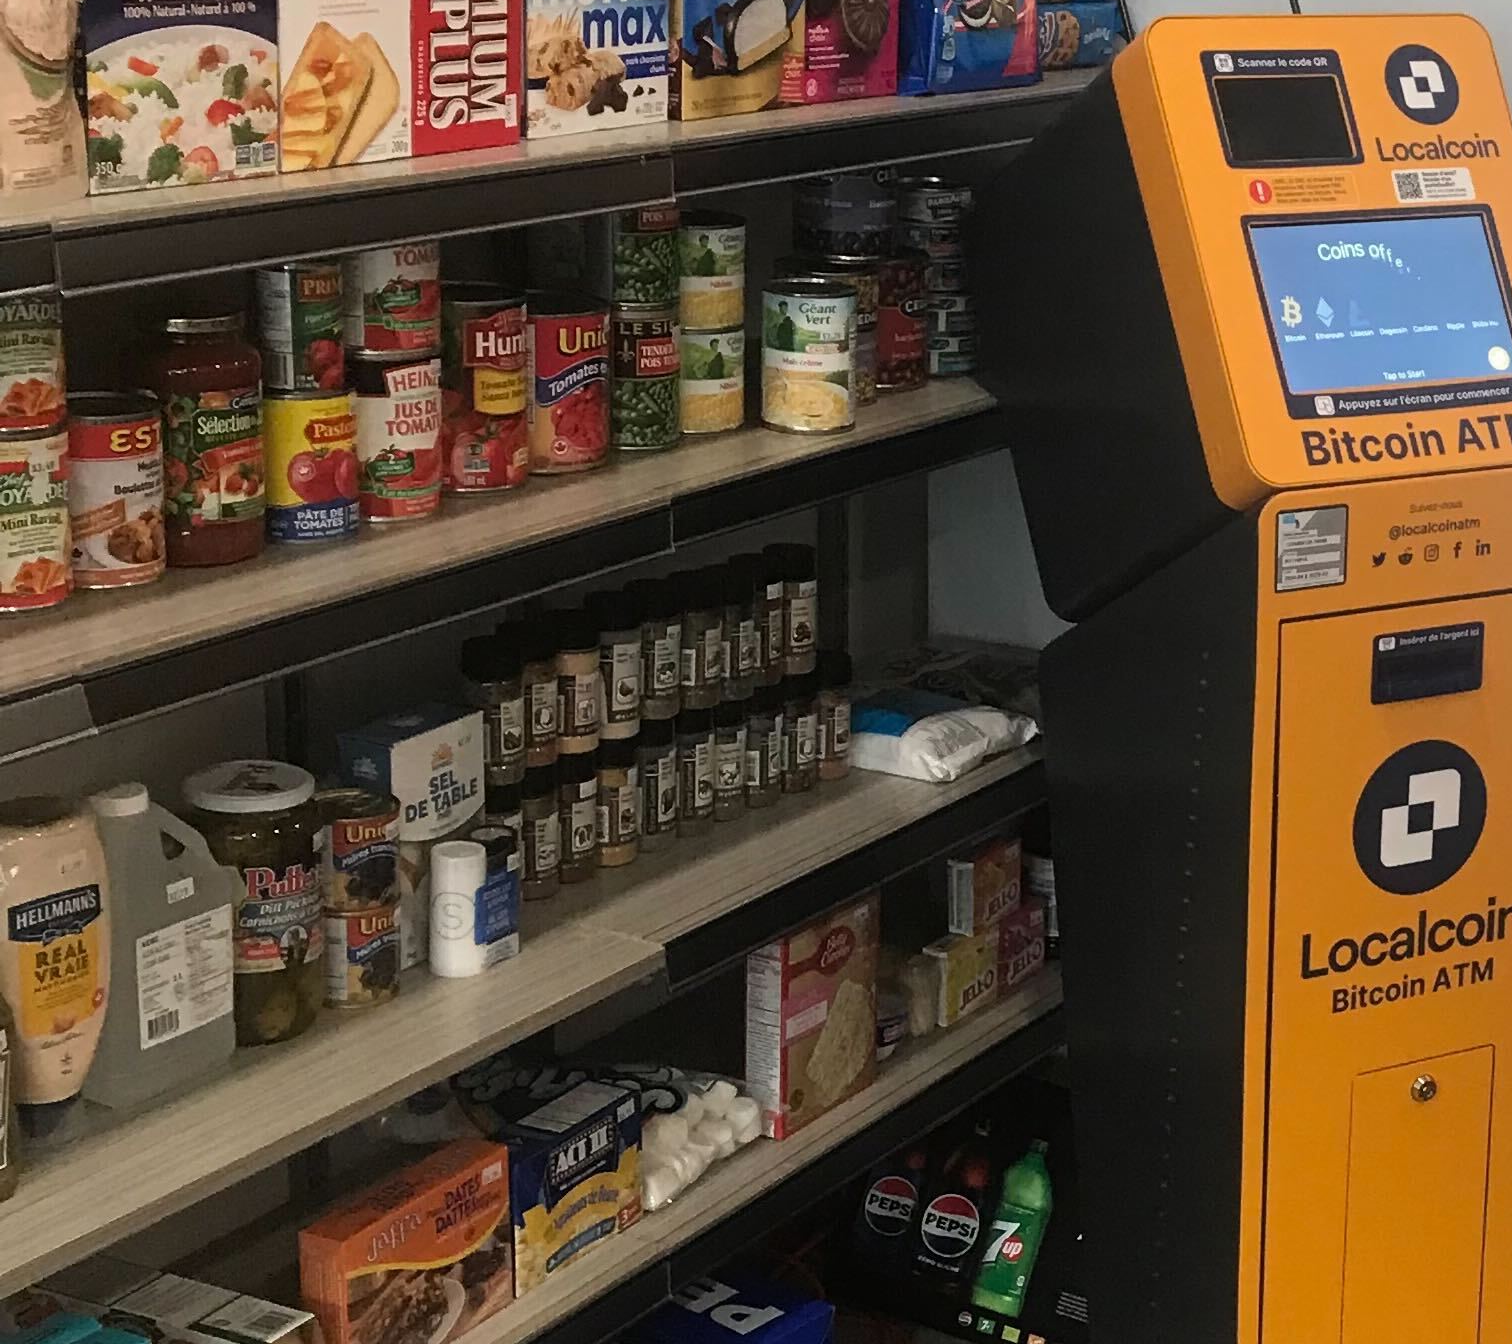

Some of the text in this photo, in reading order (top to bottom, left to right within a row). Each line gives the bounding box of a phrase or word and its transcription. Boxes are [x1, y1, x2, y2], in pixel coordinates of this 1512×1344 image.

[582, 6, 667, 49] max
[1237, 57, 1328, 69] Scanner le code QR
[1375, 132, 1500, 163] Localcoin
[1317, 240, 1366, 261] Coins
[798, 303, 837, 315] Géant
[804, 313, 831, 325] Vert
[619, 322, 644, 336] LE
[548, 364, 599, 397] Tomates
[1383, 369, 1425, 381] Tap to Start
[1338, 385, 1511, 411] Appuyez sur l'écran pour commencer
[197, 413, 250, 436] Sélection
[394, 403, 421, 420] JUS
[1301, 421, 1446, 467] Bitcoin
[0, 512, 28, 531] Mini
[293, 517, 345, 531] TOMATES
[296, 508, 345, 521] PÂTE DE
[1388, 516, 1481, 541] @localcoinatm
[1427, 633, 1439, 643] de
[428, 769, 459, 796] SEL
[404, 777, 479, 824] DE TABLE
[15, 890, 98, 930] HELLMANN'S
[34, 938, 88, 970] REAL
[33, 953, 91, 985] VRAIE
[1331, 957, 1495, 1014] Bitcoin ATM
[554, 1141, 590, 1176] ACT
[444, 1172, 482, 1210] DATES
[620, 1209, 630, 1222] 3
[924, 1211, 976, 1240] PEPSI
[367, 1212, 422, 1262] Jaffa
[981, 1219, 1022, 1264] 7
[1001, 1240, 1023, 1258] up
